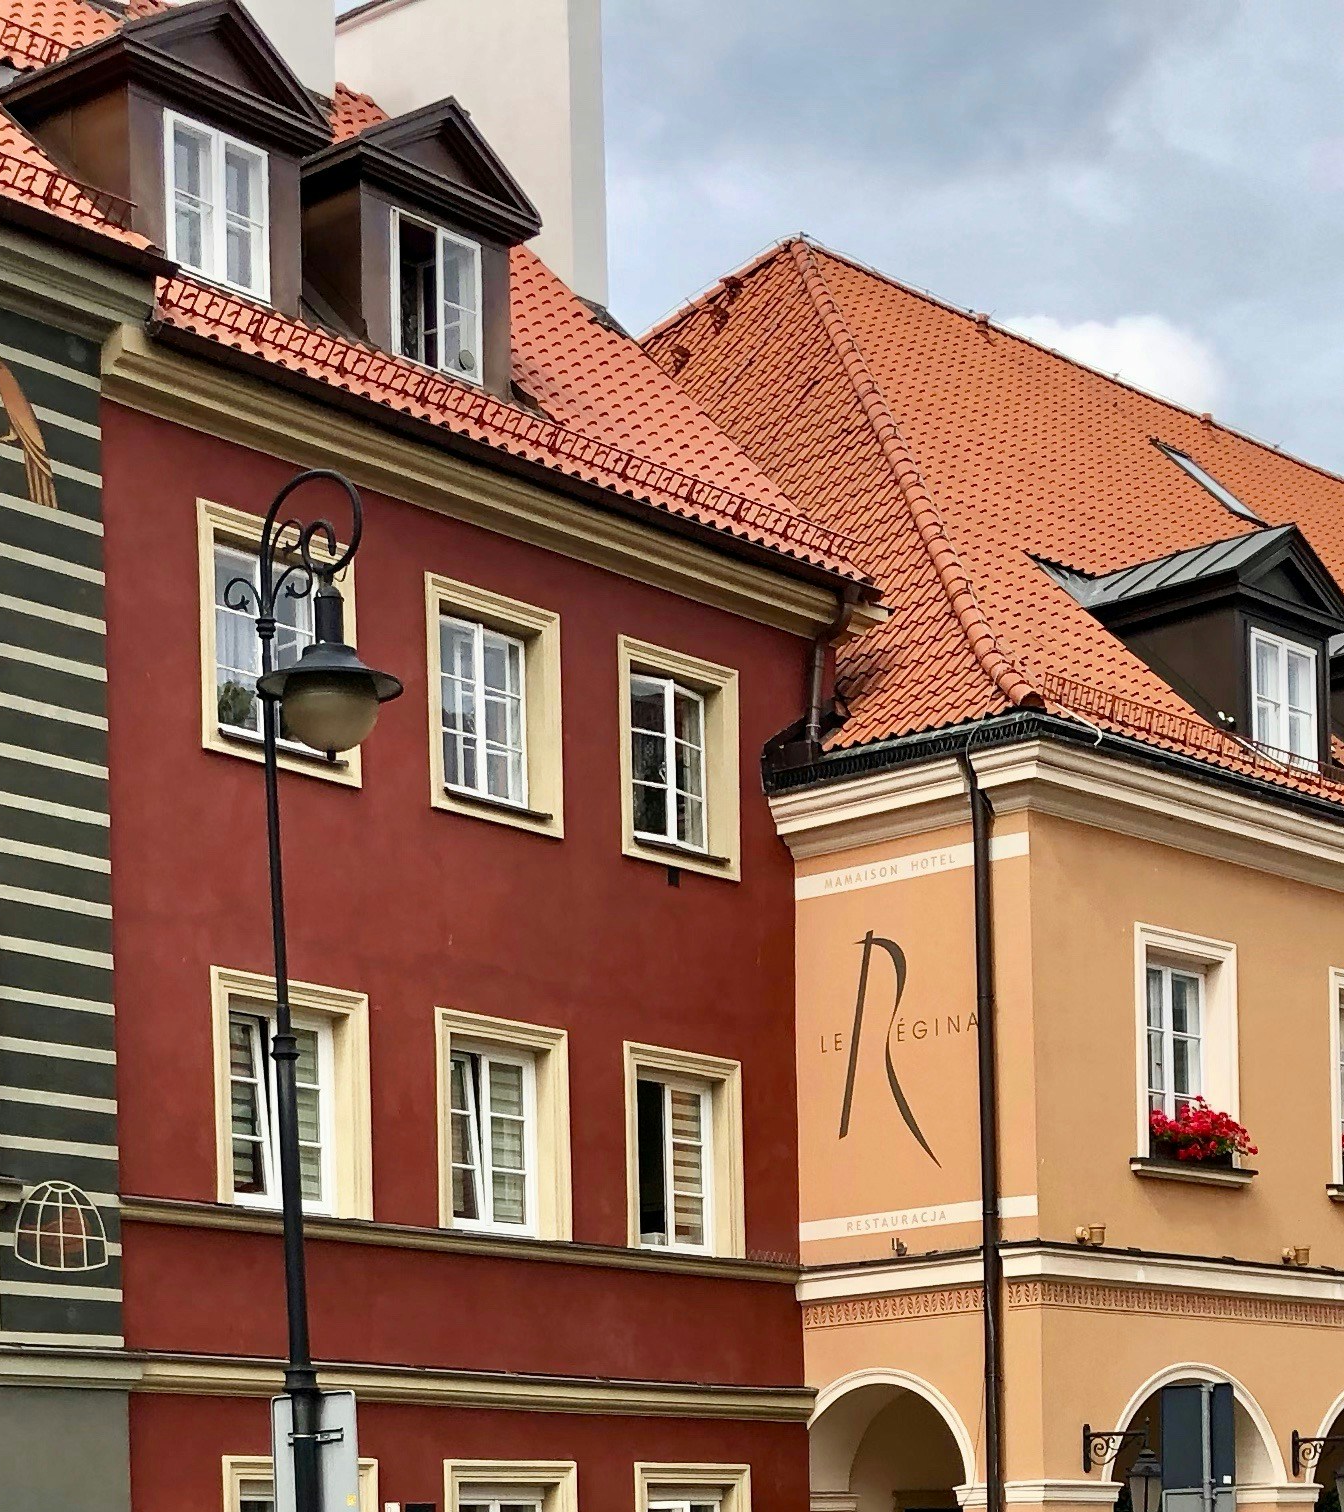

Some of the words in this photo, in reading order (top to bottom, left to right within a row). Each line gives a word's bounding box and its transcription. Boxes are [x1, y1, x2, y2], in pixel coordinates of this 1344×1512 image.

[824, 864, 899, 890] MAMAISON
[910, 853, 956, 872] HOTEL
[821, 1032, 843, 1054] LE
[846, 1210, 947, 1232] RESTAURACJA
